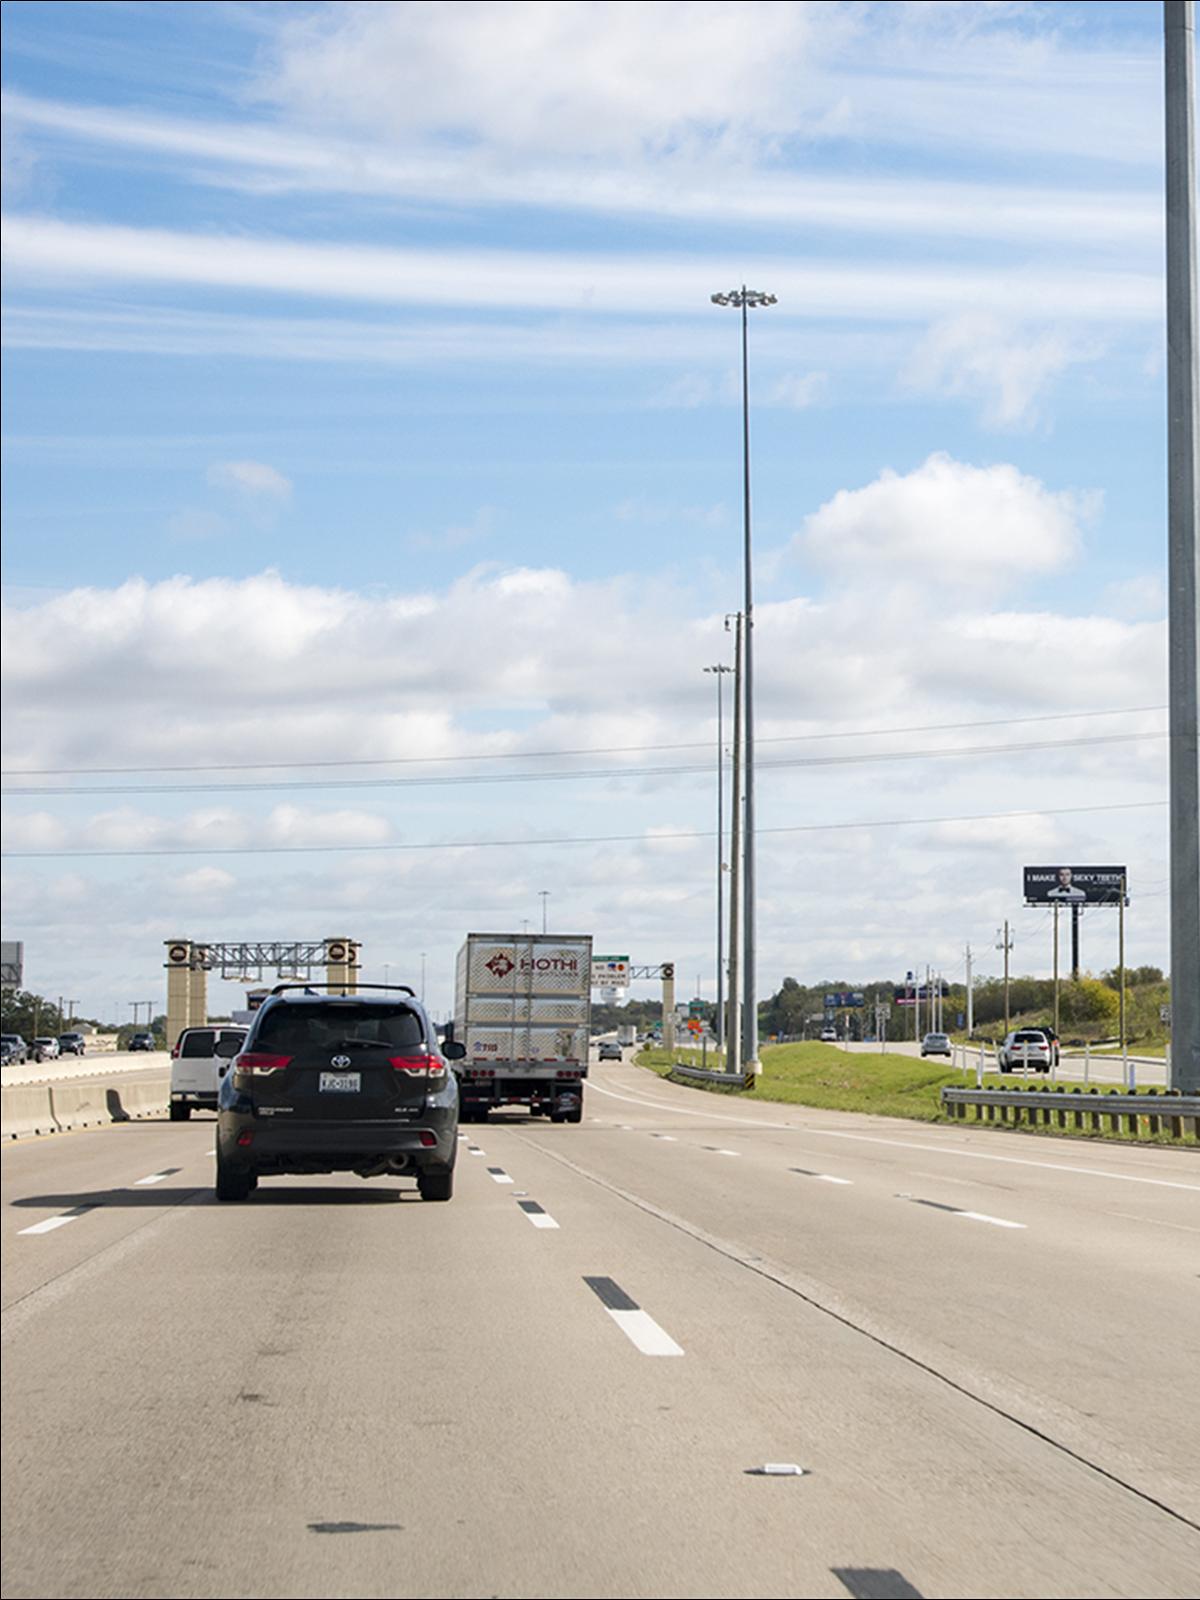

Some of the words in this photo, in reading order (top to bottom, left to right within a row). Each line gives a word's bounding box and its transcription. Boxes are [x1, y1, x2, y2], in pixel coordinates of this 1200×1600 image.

[1032, 874, 1056, 882] MAKE
[1073, 874, 1095, 882] SEXY
[520, 958, 578, 971] HOTHI
